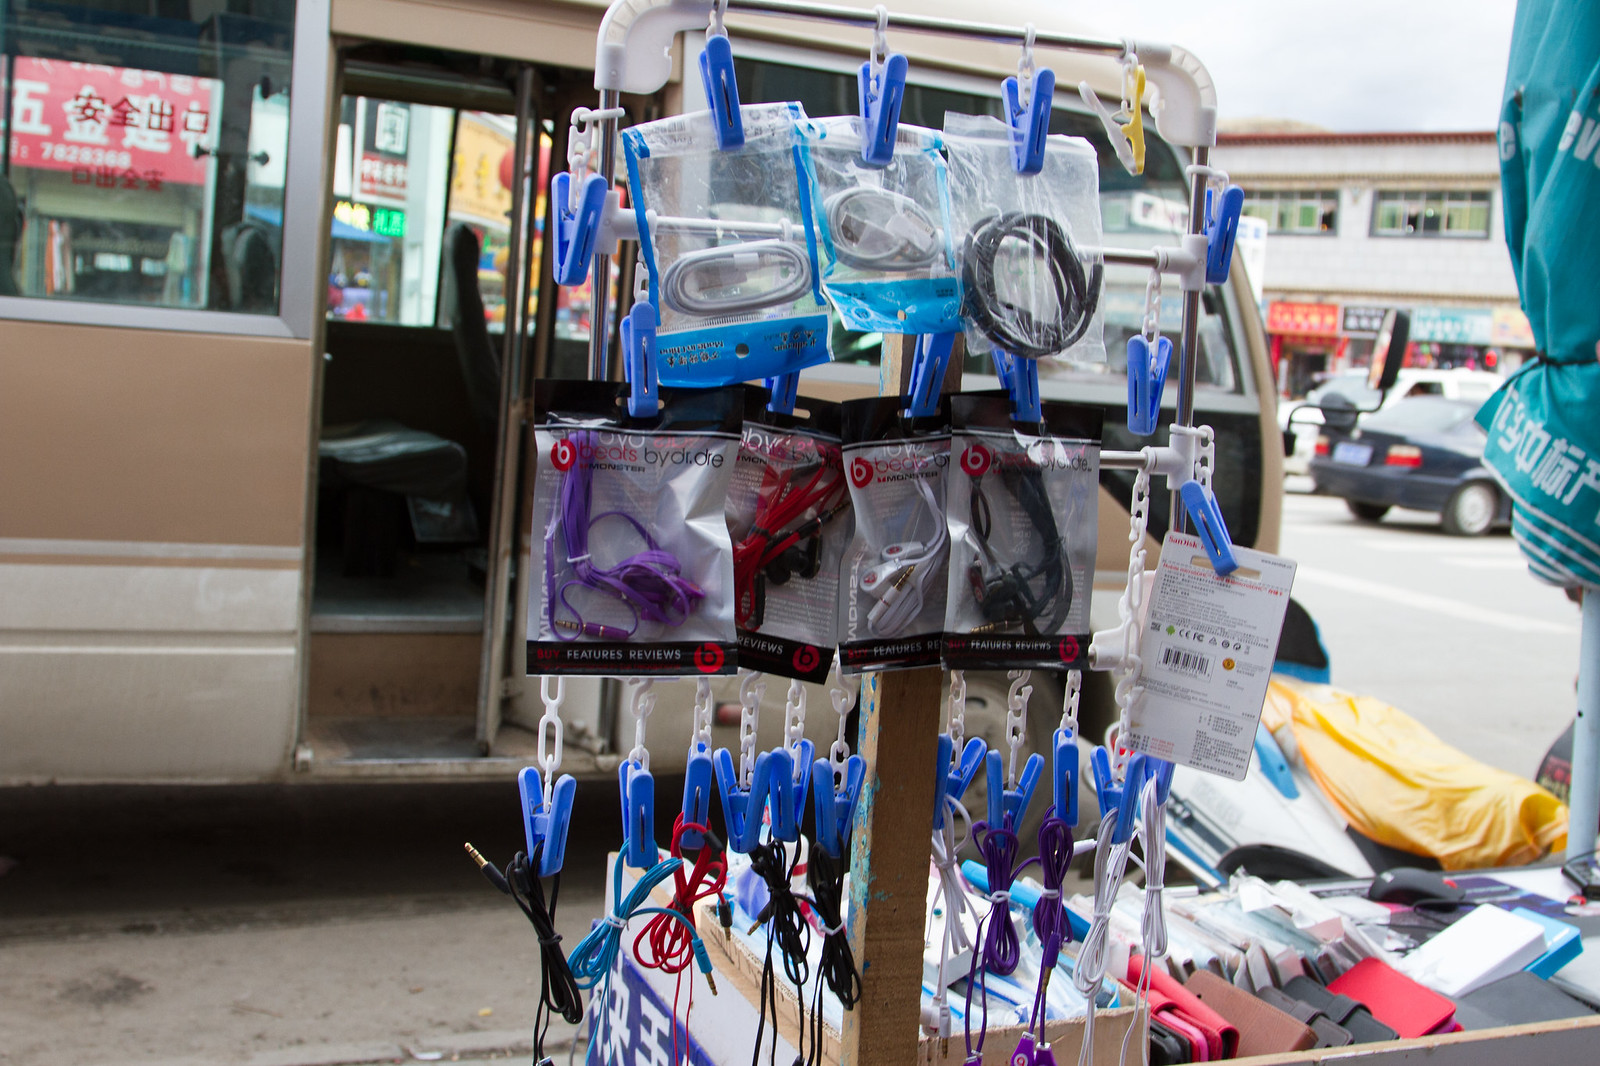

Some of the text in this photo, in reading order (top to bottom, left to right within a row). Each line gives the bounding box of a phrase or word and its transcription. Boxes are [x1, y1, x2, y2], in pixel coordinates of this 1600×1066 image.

[579, 440, 637, 463] beats
[737, 635, 783, 655] REVIEWS
[874, 643, 922, 657] FEATURES
[971, 640, 1012, 650] FEATURES
[1015, 640, 1051, 650] REVIEWS
[537, 649, 560, 659] BUY
[567, 649, 623, 660] FEATURES
[629, 649, 681, 660] REVIEWS
